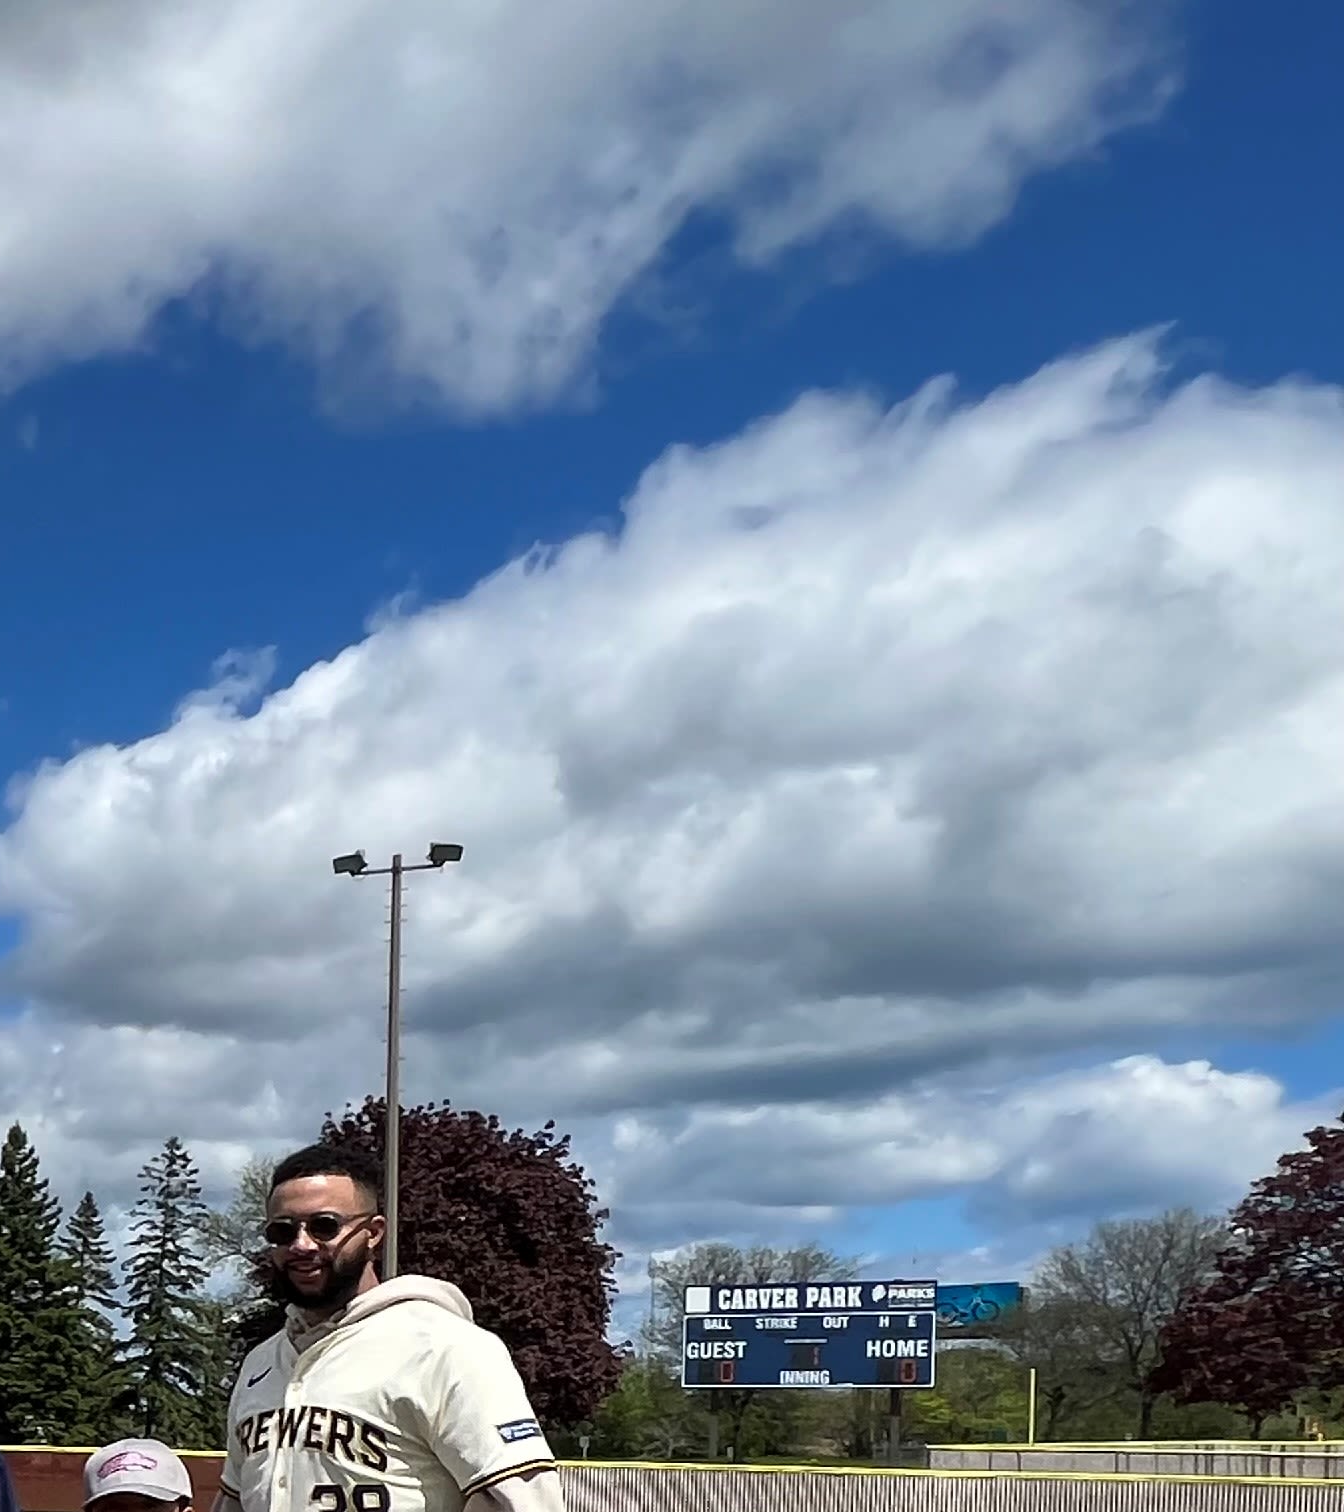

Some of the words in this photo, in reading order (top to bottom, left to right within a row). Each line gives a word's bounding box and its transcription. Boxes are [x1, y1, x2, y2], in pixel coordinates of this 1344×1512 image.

[718, 1288, 798, 1310] CARVER
[806, 1286, 862, 1308] PARK
[703, 1318, 732, 1330] BALL
[755, 1317, 798, 1330] STRIKE
[822, 1316, 849, 1329] OUT
[878, 1315, 890, 1328] H
[908, 1315, 918, 1328] E
[686, 1341, 747, 1360] GUEST
[866, 1339, 929, 1358] HOME
[779, 1370, 830, 1386] INNING
[236, 1405, 388, 1473] REWERS
